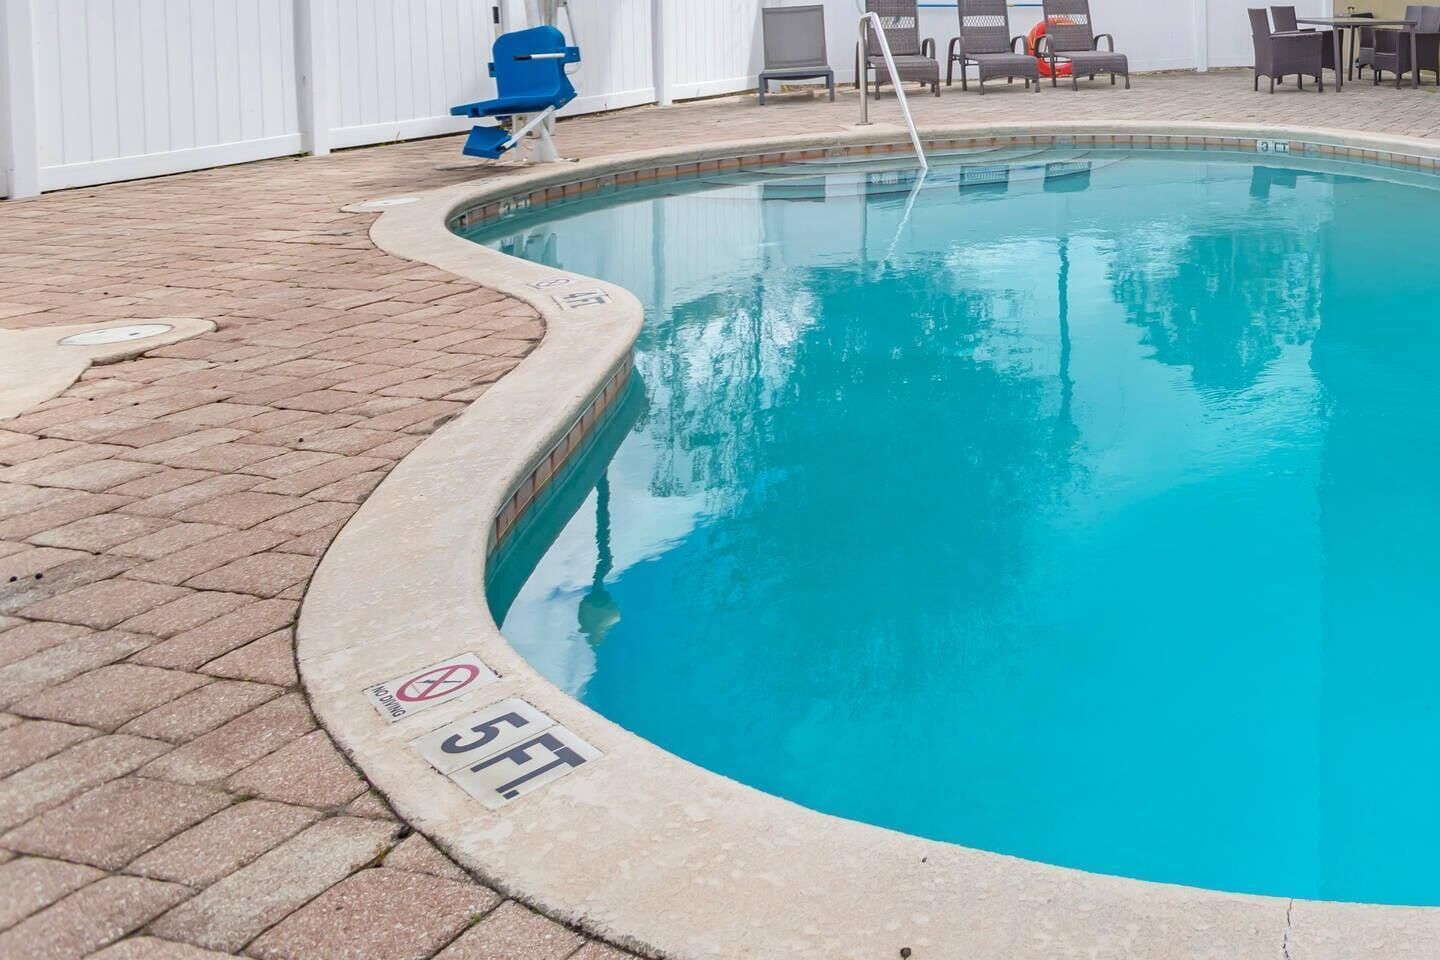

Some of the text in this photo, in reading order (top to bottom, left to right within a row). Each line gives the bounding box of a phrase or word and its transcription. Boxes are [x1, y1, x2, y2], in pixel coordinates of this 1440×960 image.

[1261, 141, 1288, 153] 3 FT
[371, 685, 406, 718] NO DIVING
[440, 711, 530, 755] 5
